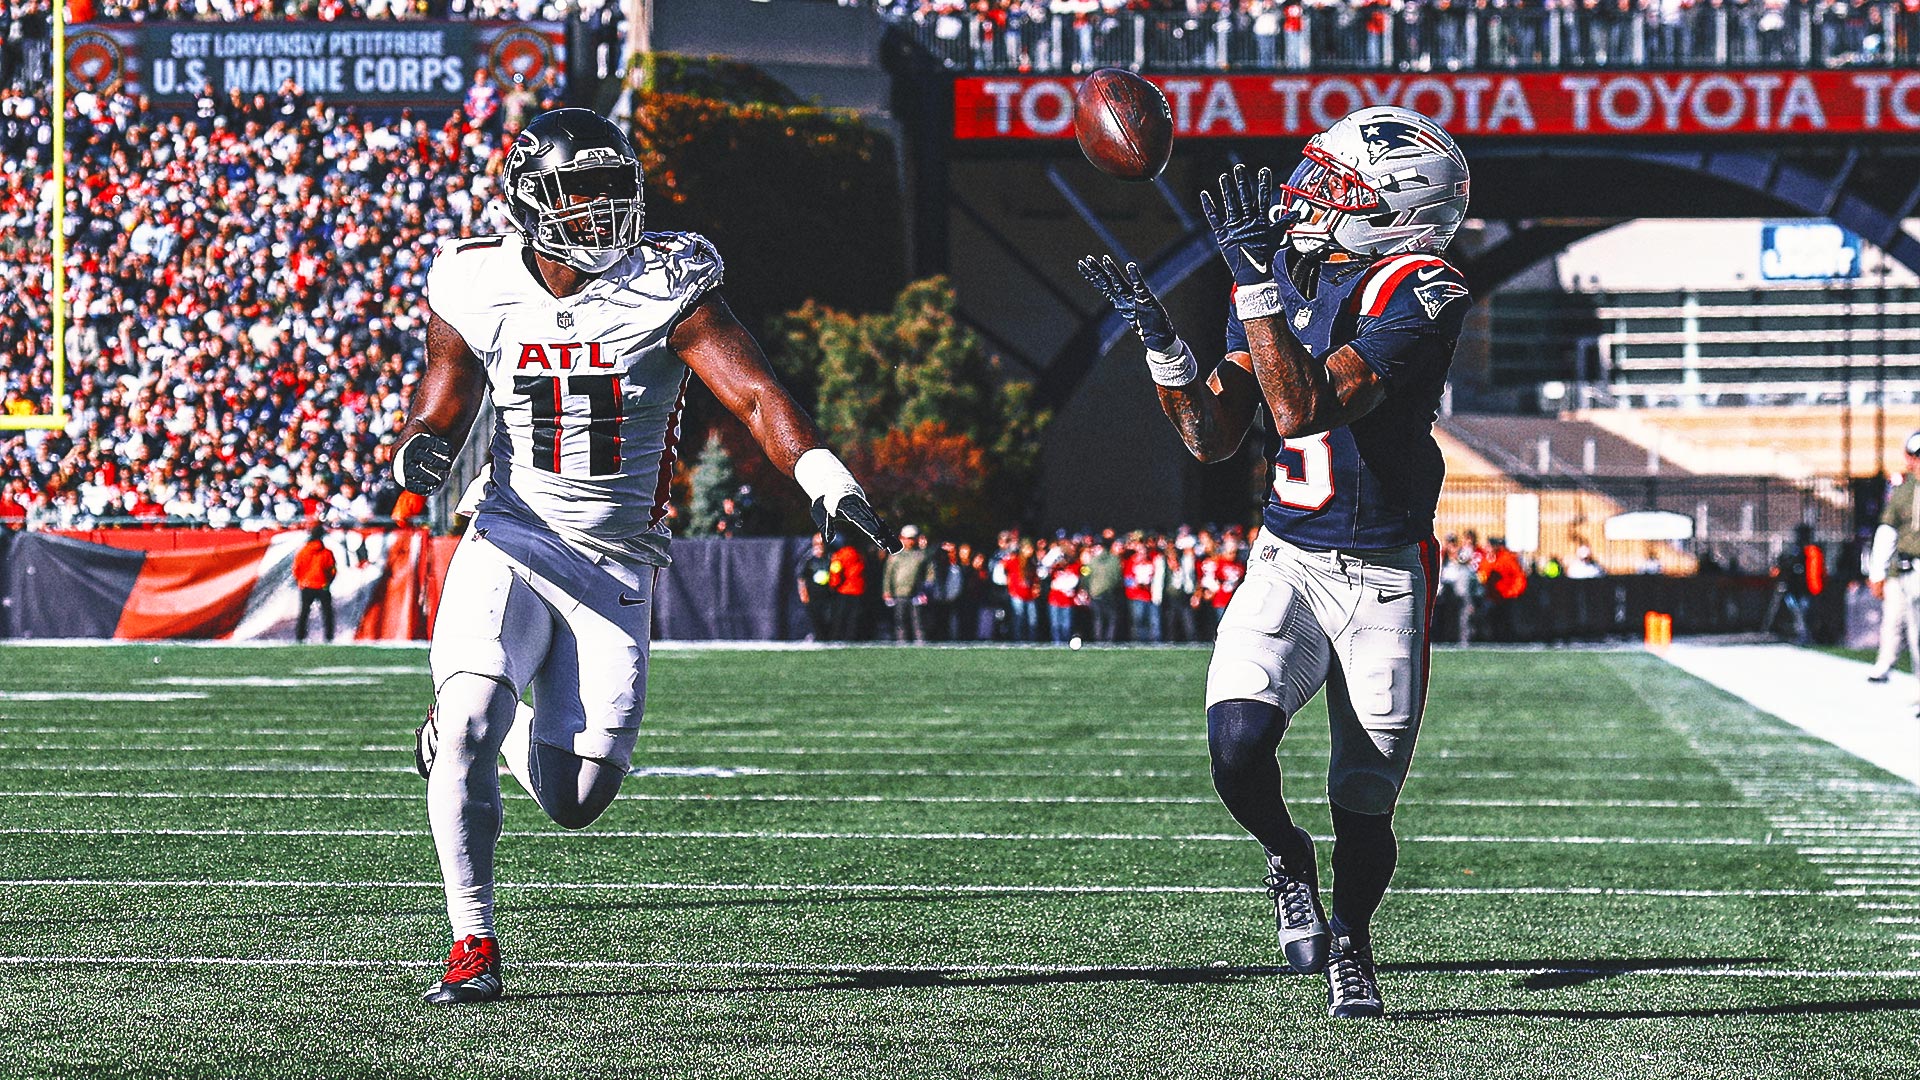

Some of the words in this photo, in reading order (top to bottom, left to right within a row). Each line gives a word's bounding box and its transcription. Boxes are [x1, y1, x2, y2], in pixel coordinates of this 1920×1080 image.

[171, 31, 212, 58] SGT
[224, 57, 345, 93] MARINE
[354, 56, 463, 93] CORPS
[983, 80, 1247, 134] TOTA
[1272, 78, 1537, 132] TOYOTA
[1560, 75, 1827, 131] TOYOTA
[517, 341, 616, 370] ATL
[513, 374, 623, 477] 11
